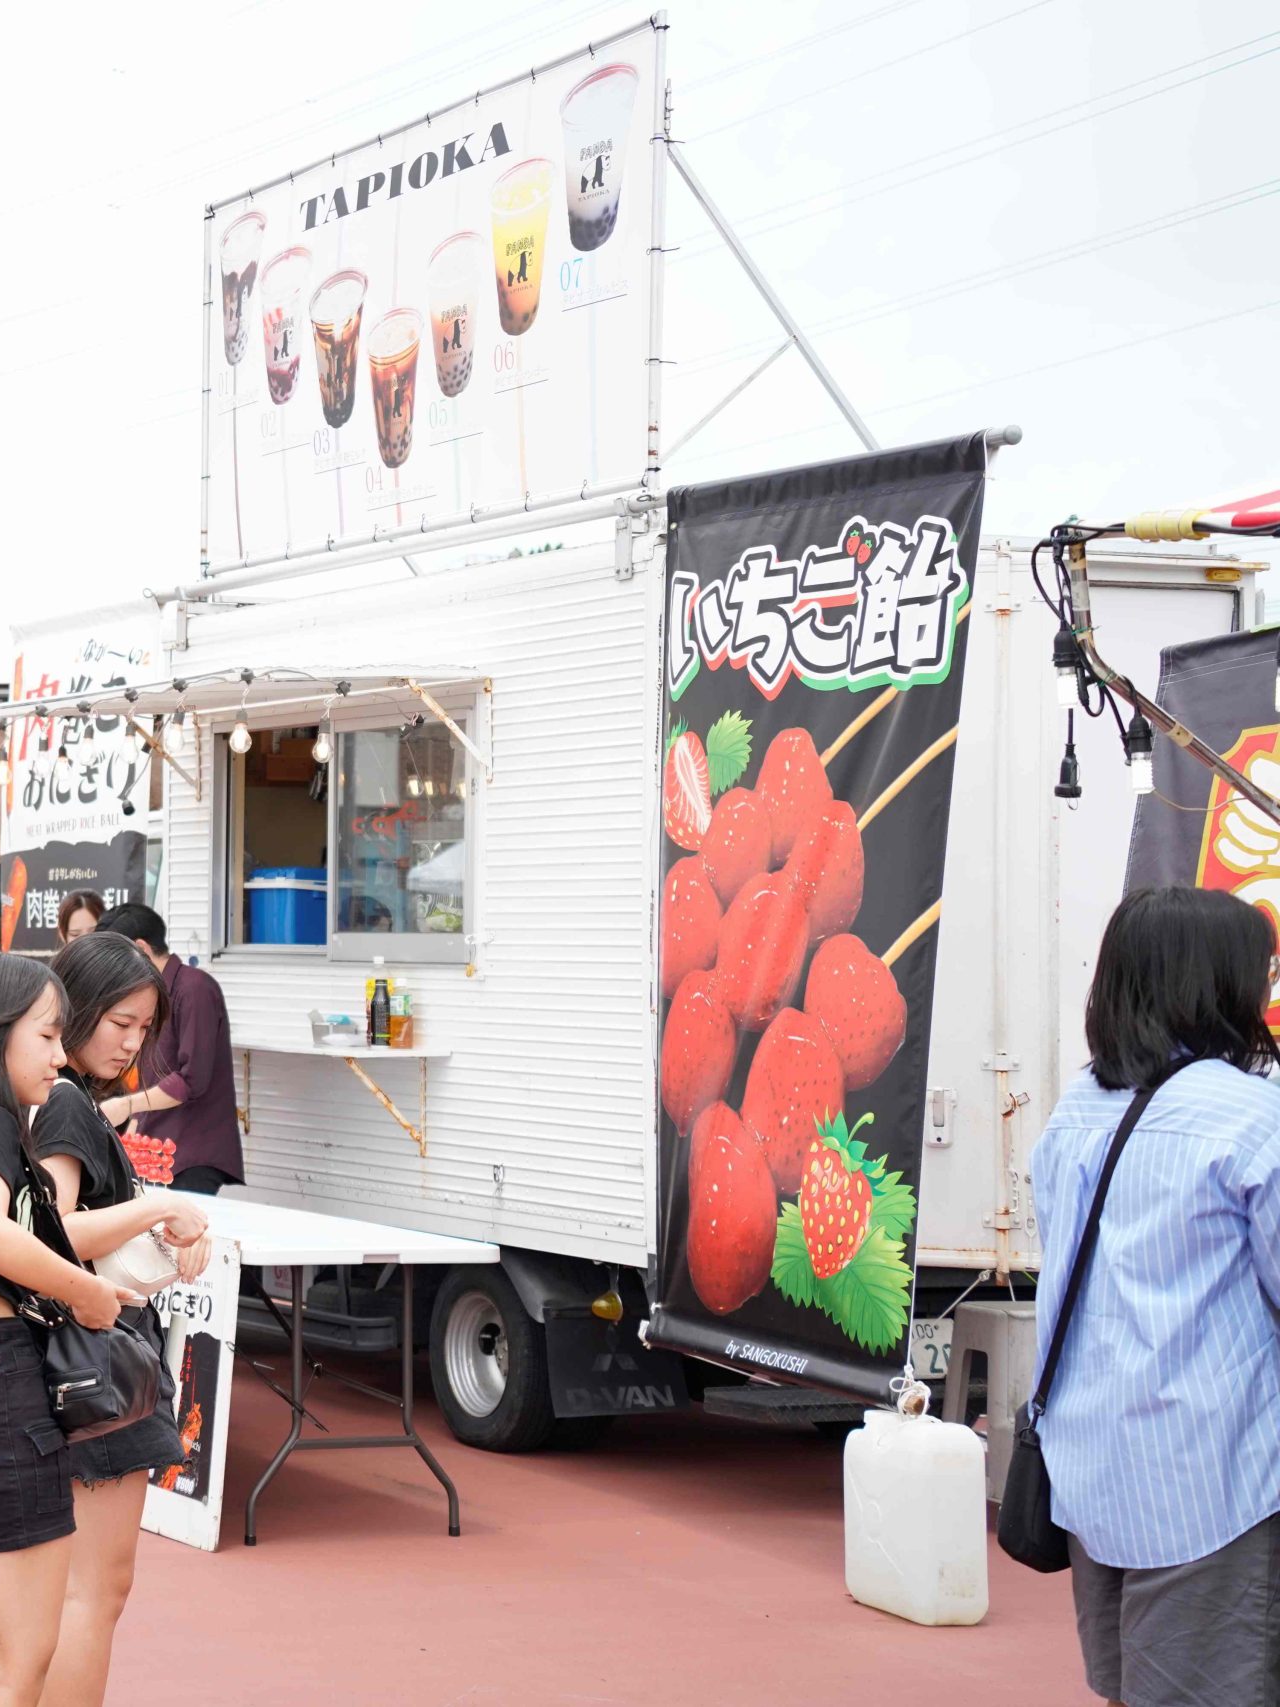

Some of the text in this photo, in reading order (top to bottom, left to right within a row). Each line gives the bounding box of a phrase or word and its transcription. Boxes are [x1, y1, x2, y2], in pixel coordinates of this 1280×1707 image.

[579, 138, 613, 162] PANDA
[299, 121, 514, 233] TAPIOKA
[506, 234, 535, 256] PANDA
[560, 257, 583, 292] 07
[441, 303, 468, 324] PANDA
[493, 340, 515, 373] 06
[260, 410, 277, 439] 02
[428, 398, 448, 429] 05
[313, 428, 330, 457] 03
[365, 465, 383, 494] 04
[669, 515, 968, 700] いちご飴
[23, 751, 136, 812] おにぎり
[725, 1339, 809, 1374] by SANGOKUSHI
